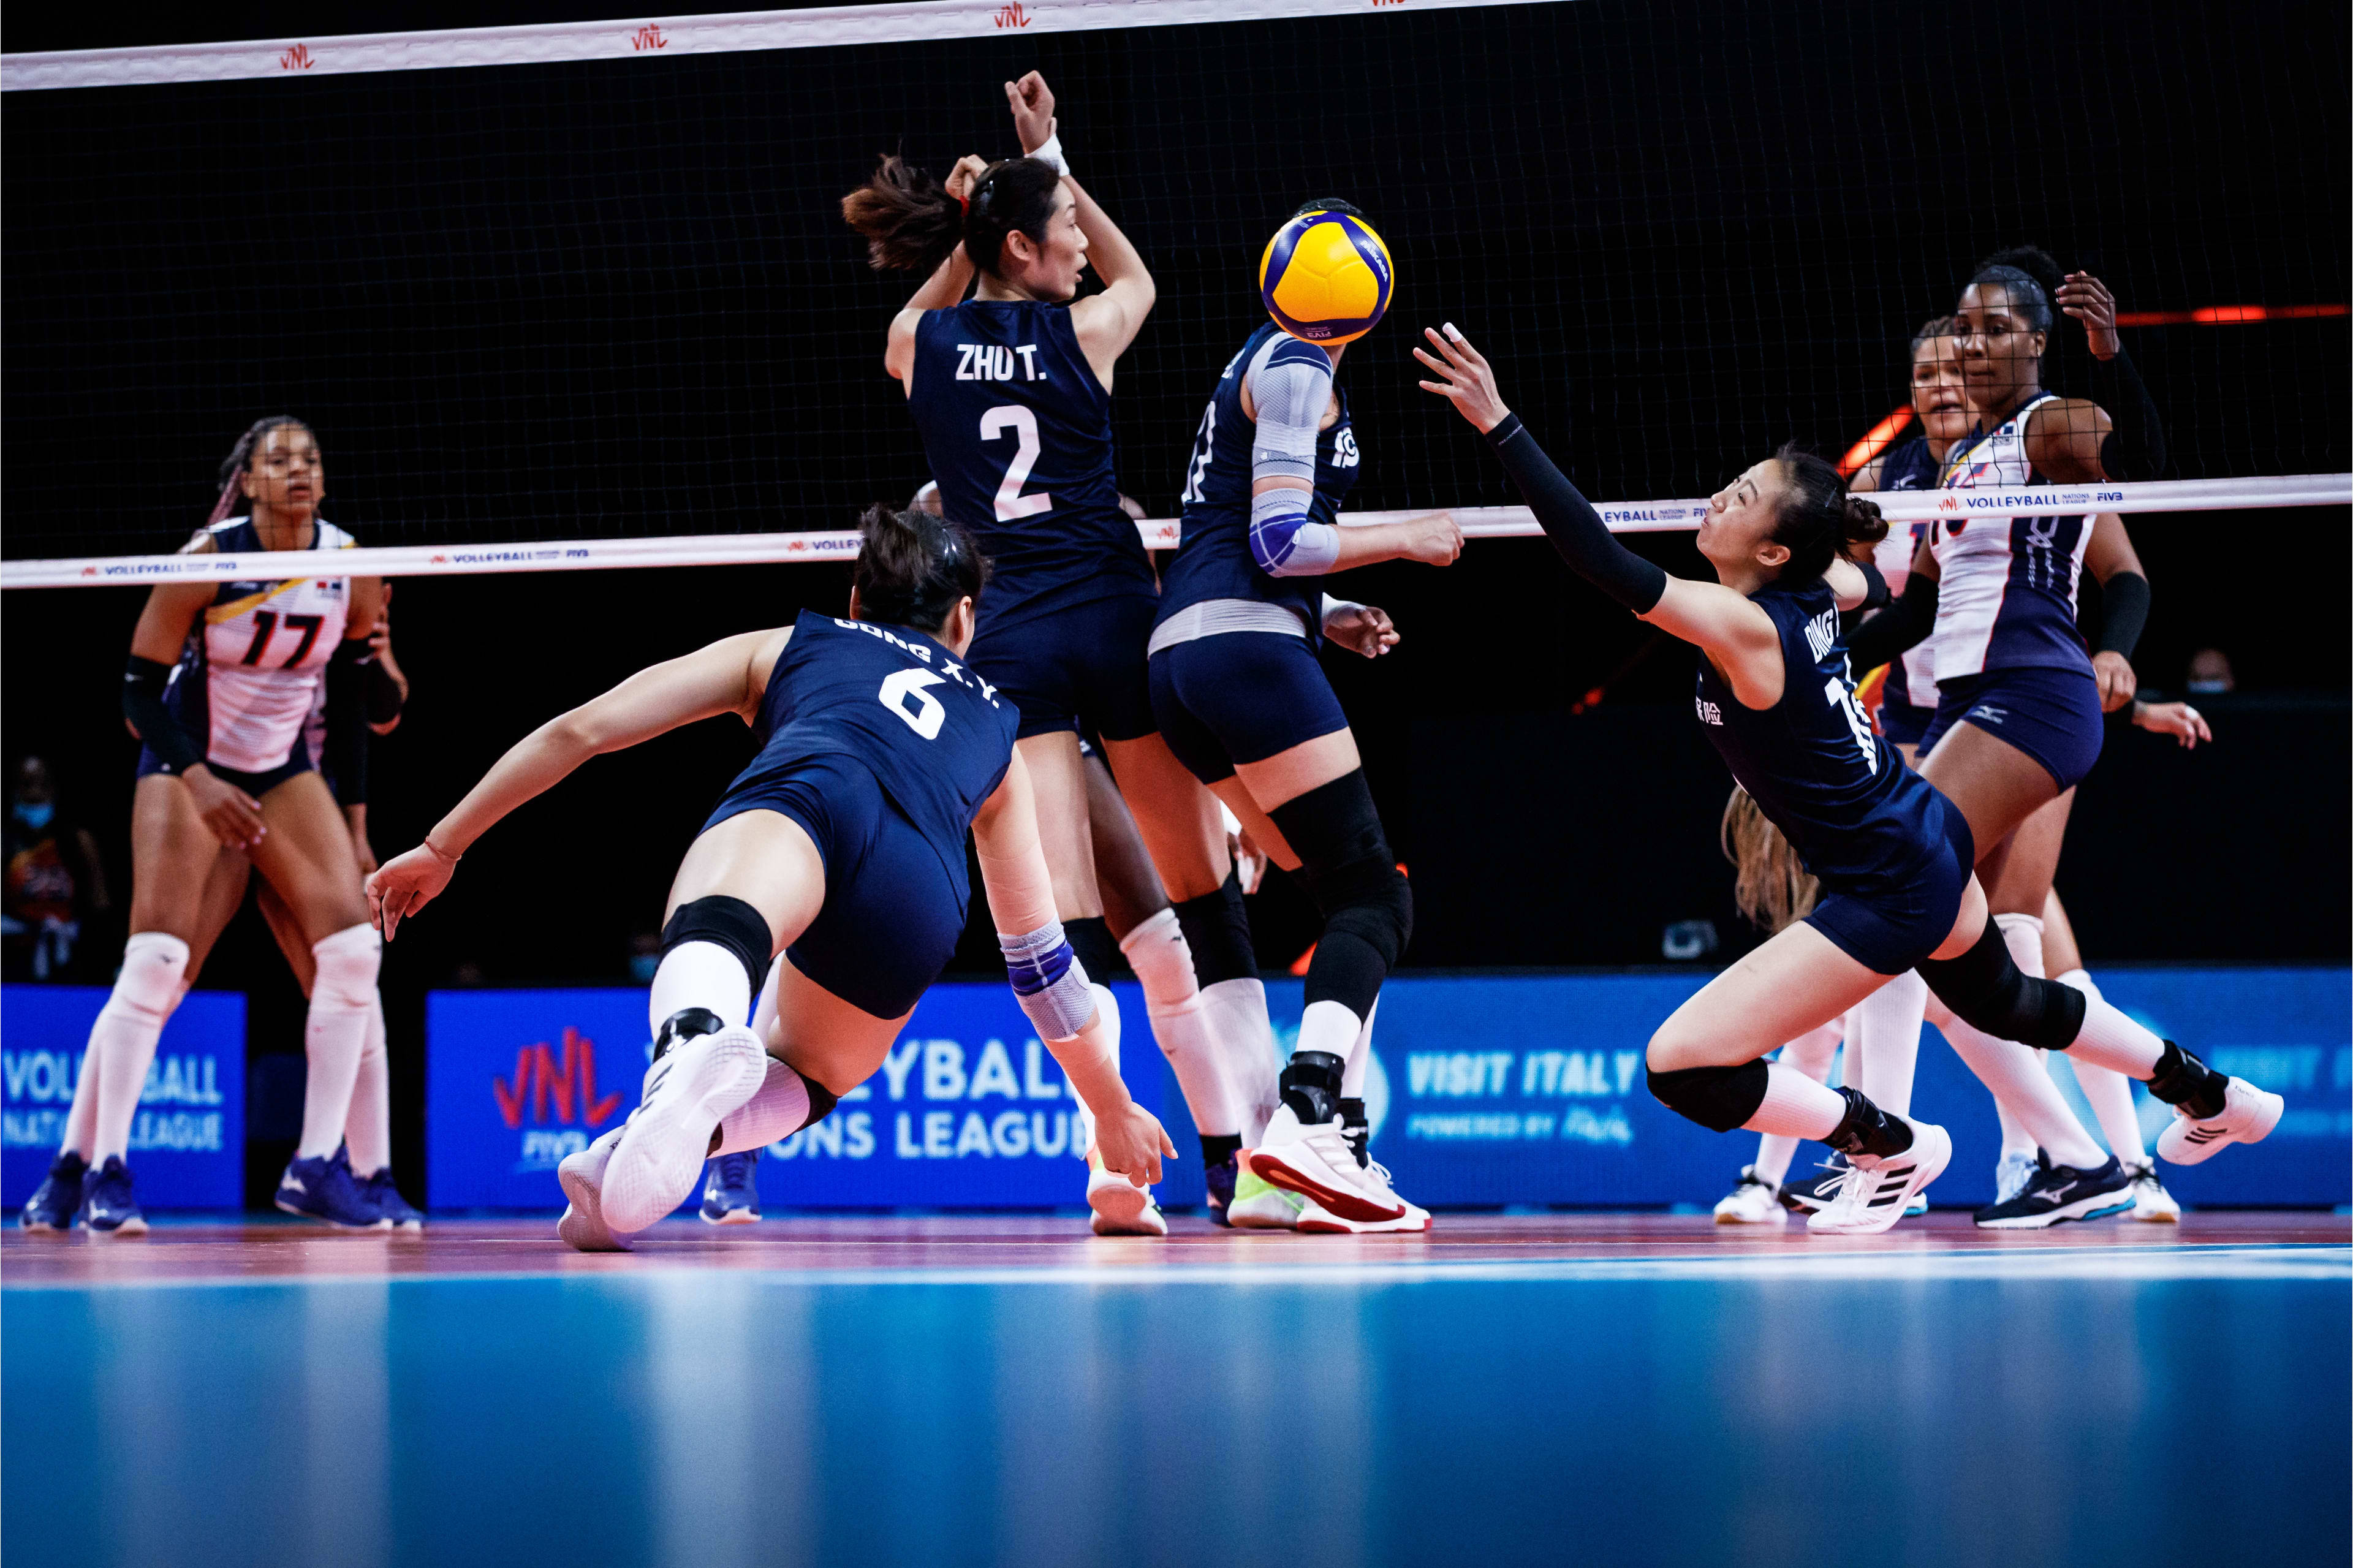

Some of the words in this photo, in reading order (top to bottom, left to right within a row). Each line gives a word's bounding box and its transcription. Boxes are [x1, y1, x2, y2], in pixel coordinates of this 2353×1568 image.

[955, 344, 1014, 381] ZHU
[1015, 344, 1047, 381] T.
[980, 404, 1053, 523] 2
[1597, 510, 1657, 523] EYBALL
[1938, 495, 1961, 512] VNL
[1966, 494, 2060, 509] VOLLEYBALL
[2097, 492, 2123, 501] FIVB
[105, 563, 182, 575] VOLLEYBALL
[453, 552, 532, 563] VOLLEYBALL
[240, 610, 326, 669] 17
[1804, 608, 1834, 664] DING
[878, 667, 947, 740] 6
[941, 657, 999, 709] X.Y.
[2, 1049, 224, 1105] VOLBALL
[494, 1026, 623, 1128] VNL
[838, 1039, 1077, 1101] YBAL
[1408, 1050, 1515, 1098] VISIT
[1522, 1050, 1642, 1098] ITALY
